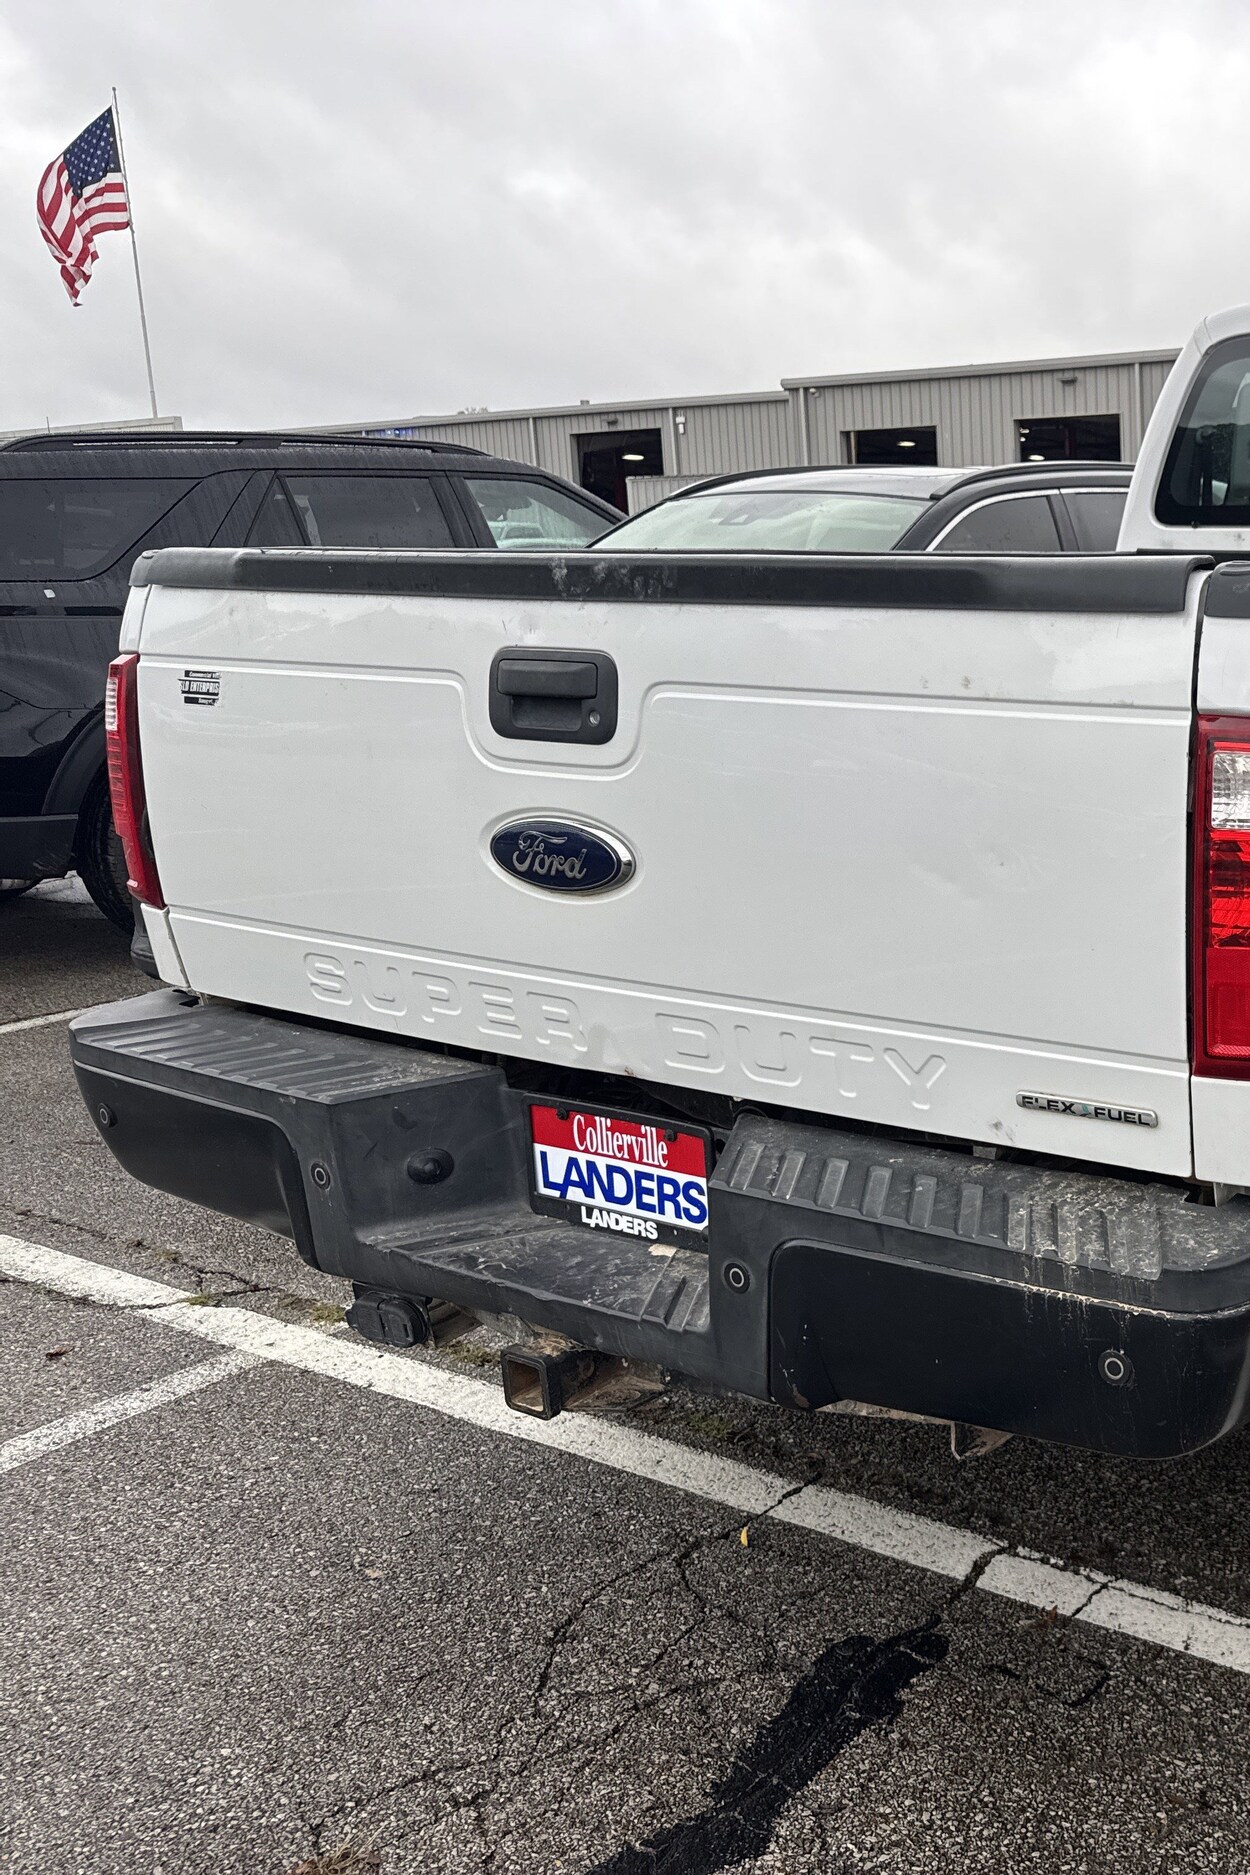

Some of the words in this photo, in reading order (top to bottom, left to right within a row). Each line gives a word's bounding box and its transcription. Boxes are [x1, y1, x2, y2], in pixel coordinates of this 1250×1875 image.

[512, 830, 588, 880] Ford
[303, 952, 588, 1051] SUPER
[654, 1012, 947, 1110] DUTY
[1021, 1095, 1076, 1114] FLEX
[1094, 1106, 1151, 1127] FUEL
[572, 1114, 669, 1168] Collierville
[540, 1150, 708, 1224] LANDERS
[580, 1205, 658, 1240] LANDERS
